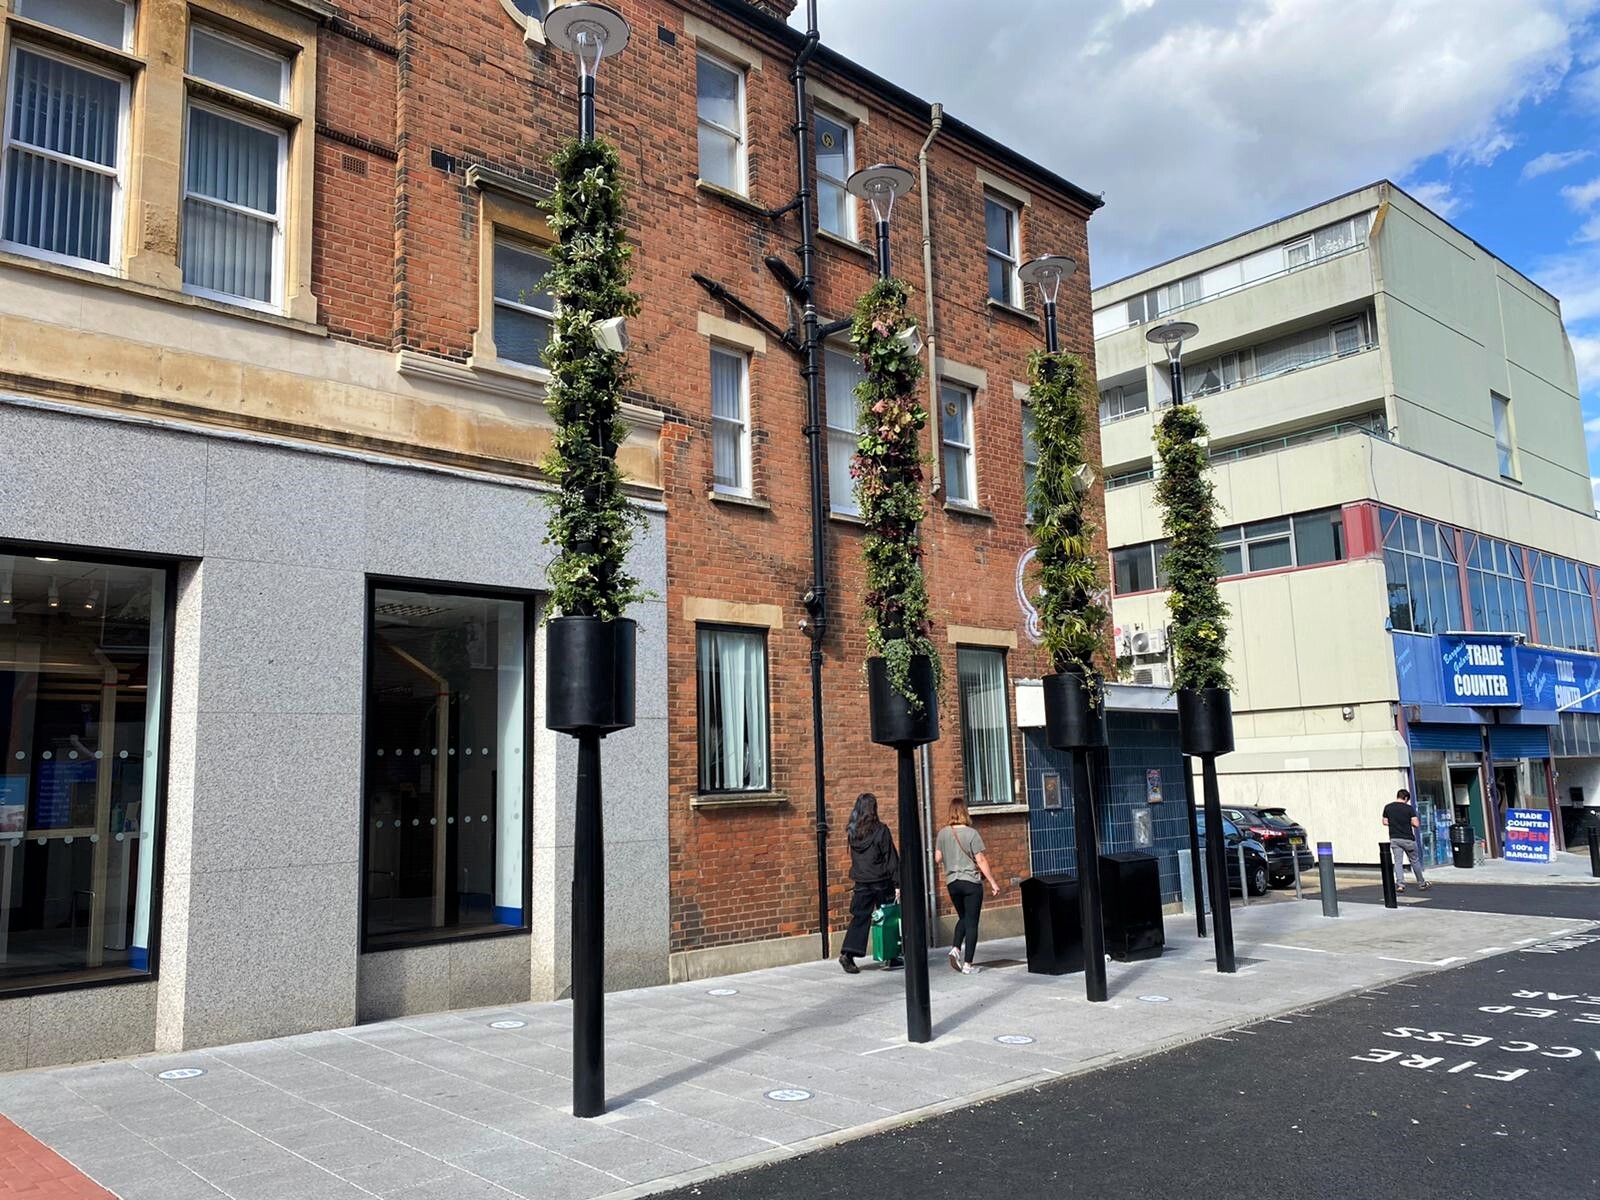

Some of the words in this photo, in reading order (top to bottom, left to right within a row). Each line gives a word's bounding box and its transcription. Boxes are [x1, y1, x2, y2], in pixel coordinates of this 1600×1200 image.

[1466, 644, 1504, 666] TRADE
[1454, 674, 1509, 696] COUNTER
[1507, 820, 1549, 828] COUNTER
[1514, 812, 1543, 820] TRADE
[1508, 831, 1549, 842] OPEN
[1506, 851, 1548, 860] BARGAINS
[1511, 989, 1600, 1005] EAR
[1478, 1005, 1600, 1024] EEP
[1382, 1026, 1600, 1061] CCESS
[1350, 1048, 1530, 1082] FIRE
